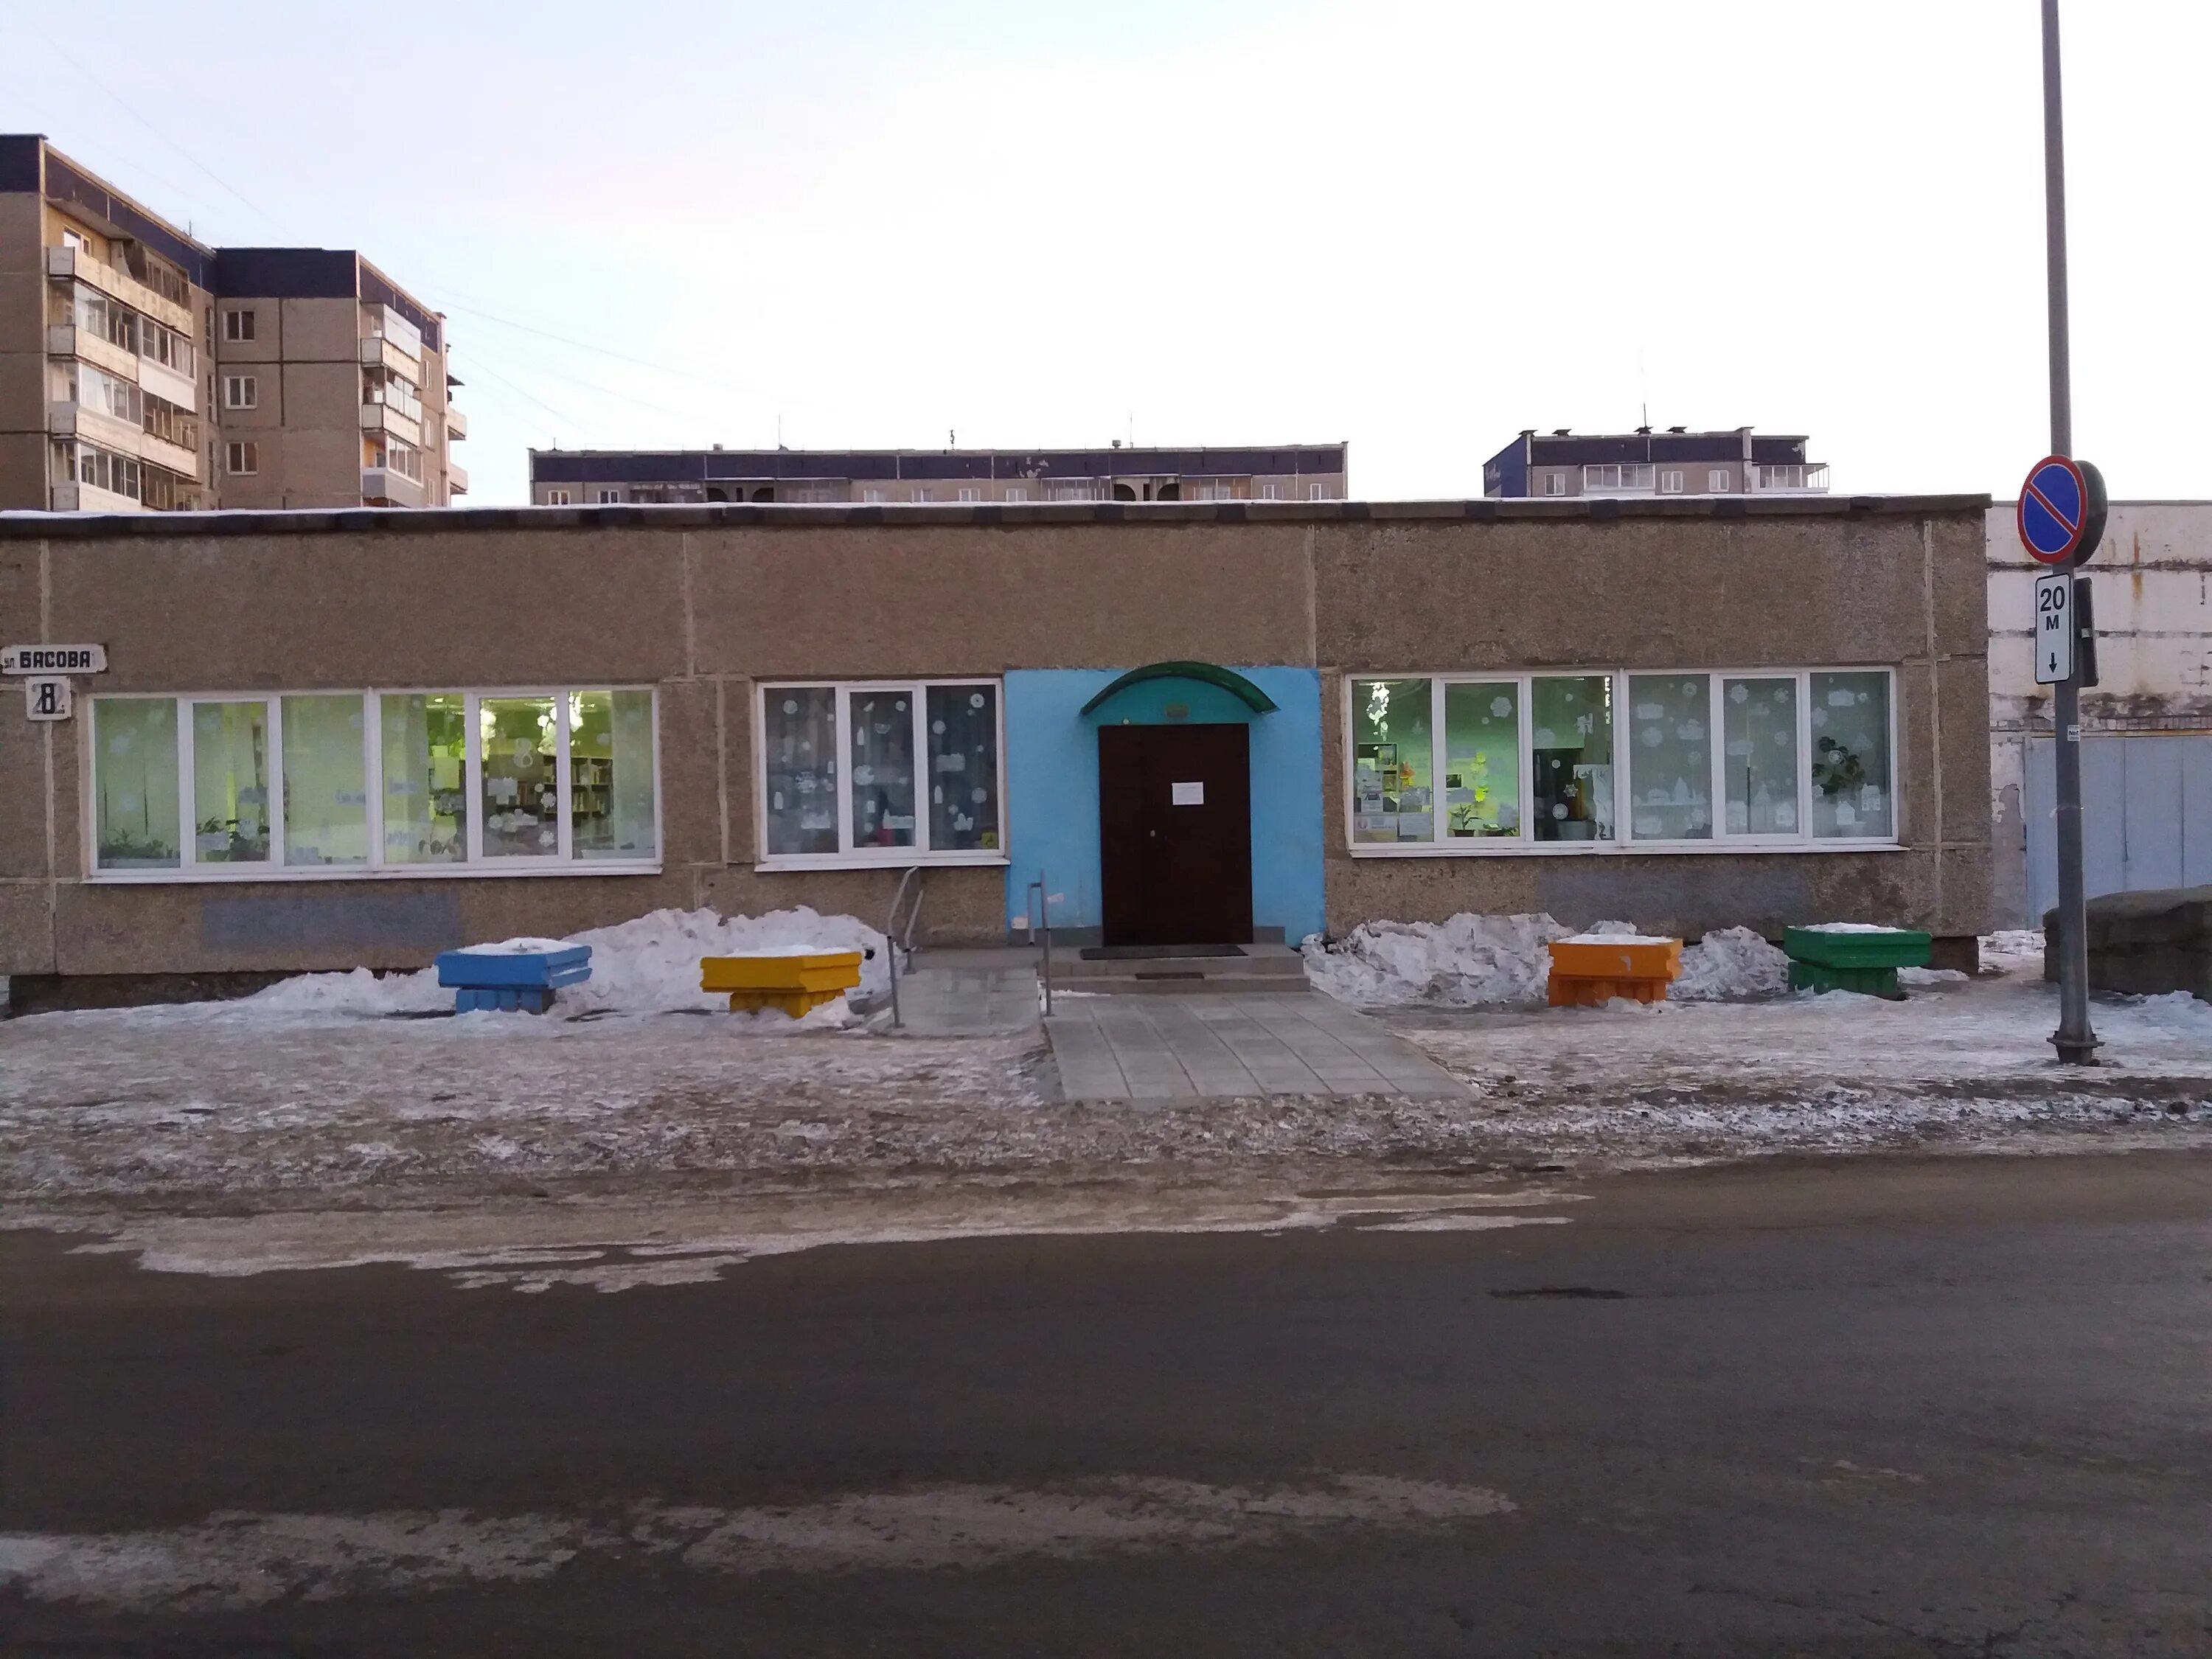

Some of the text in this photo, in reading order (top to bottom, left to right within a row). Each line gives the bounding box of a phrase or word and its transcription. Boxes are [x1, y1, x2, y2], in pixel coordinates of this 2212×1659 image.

[2040, 585, 2065, 612] 20
[2046, 614, 2059, 630] М
[20, 651, 90, 668] БАСОВА
[41, 683, 55, 714] 8
